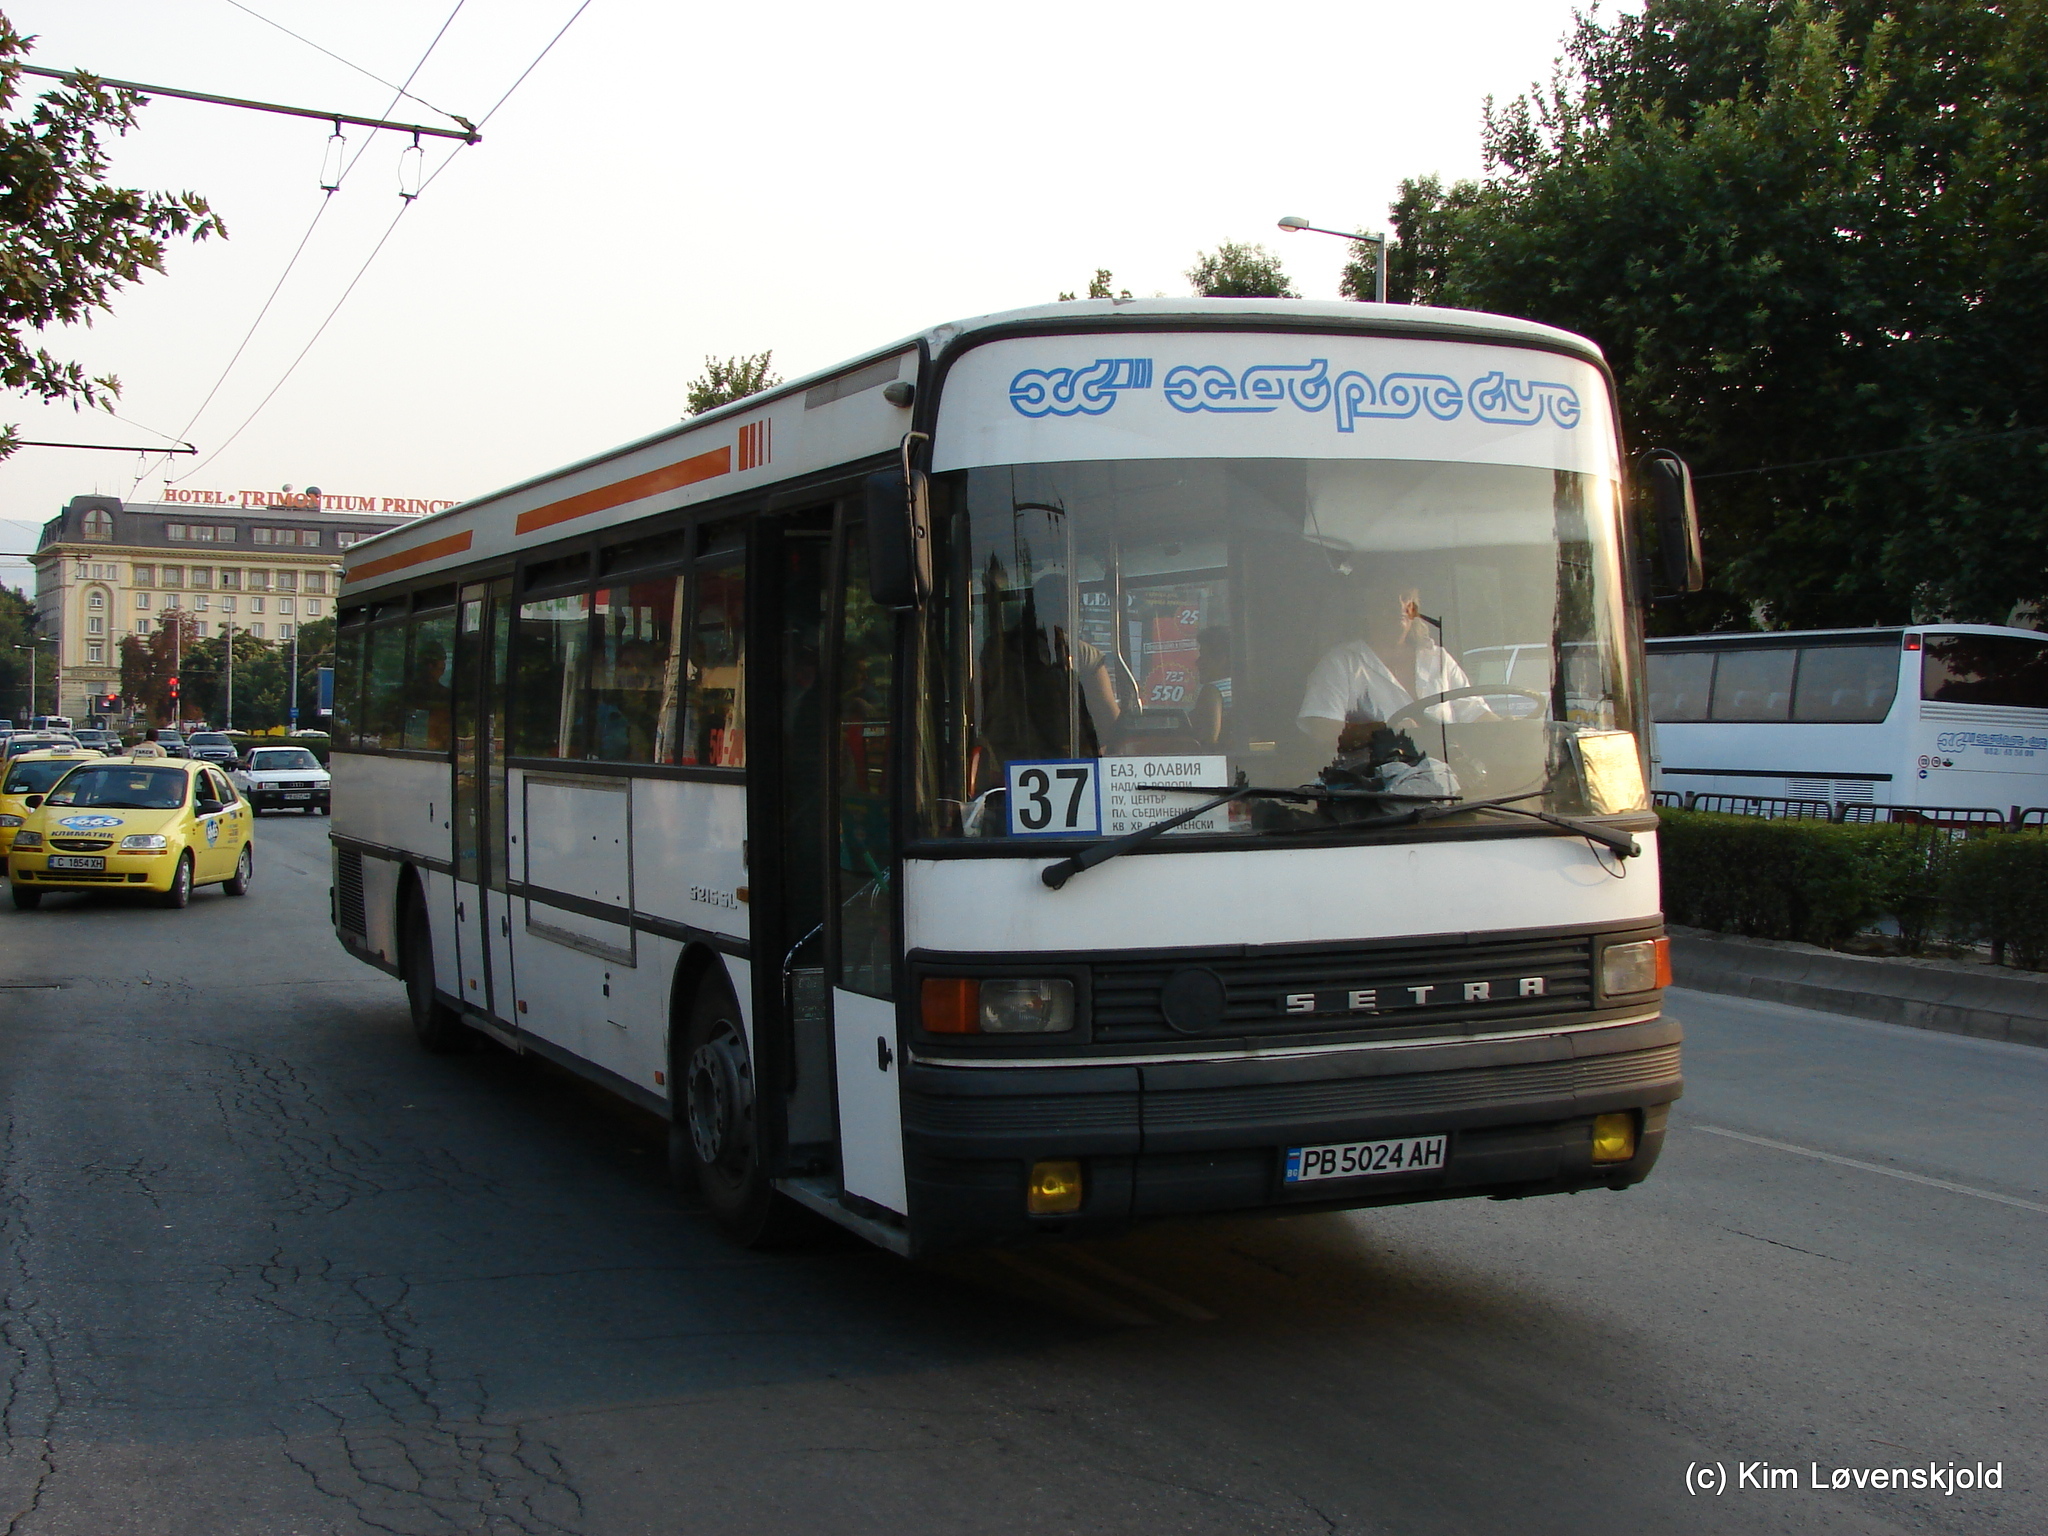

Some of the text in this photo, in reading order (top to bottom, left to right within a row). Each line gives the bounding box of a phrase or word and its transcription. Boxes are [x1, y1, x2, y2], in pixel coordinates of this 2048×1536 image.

[164, 489, 226, 503] HOTEL
[239, 490, 376, 512] TRIMONTIUM
[1151, 685, 1185, 702] 550
[1110, 762, 1202, 779] ЕАЗ, ФЛАВИЯ
[1019, 768, 1089, 830] 37
[1130, 794, 1167, 806] ЦЕНТЪР
[61, 817, 119, 826] 6665
[51, 830, 115, 839] КЛИМАТИК
[69, 858, 89, 868] 1854
[1286, 976, 1544, 1013] SETRA
[1302, 1139, 1443, 1177] PB 5024 AH
[1287, 1168, 1299, 1178] BG
